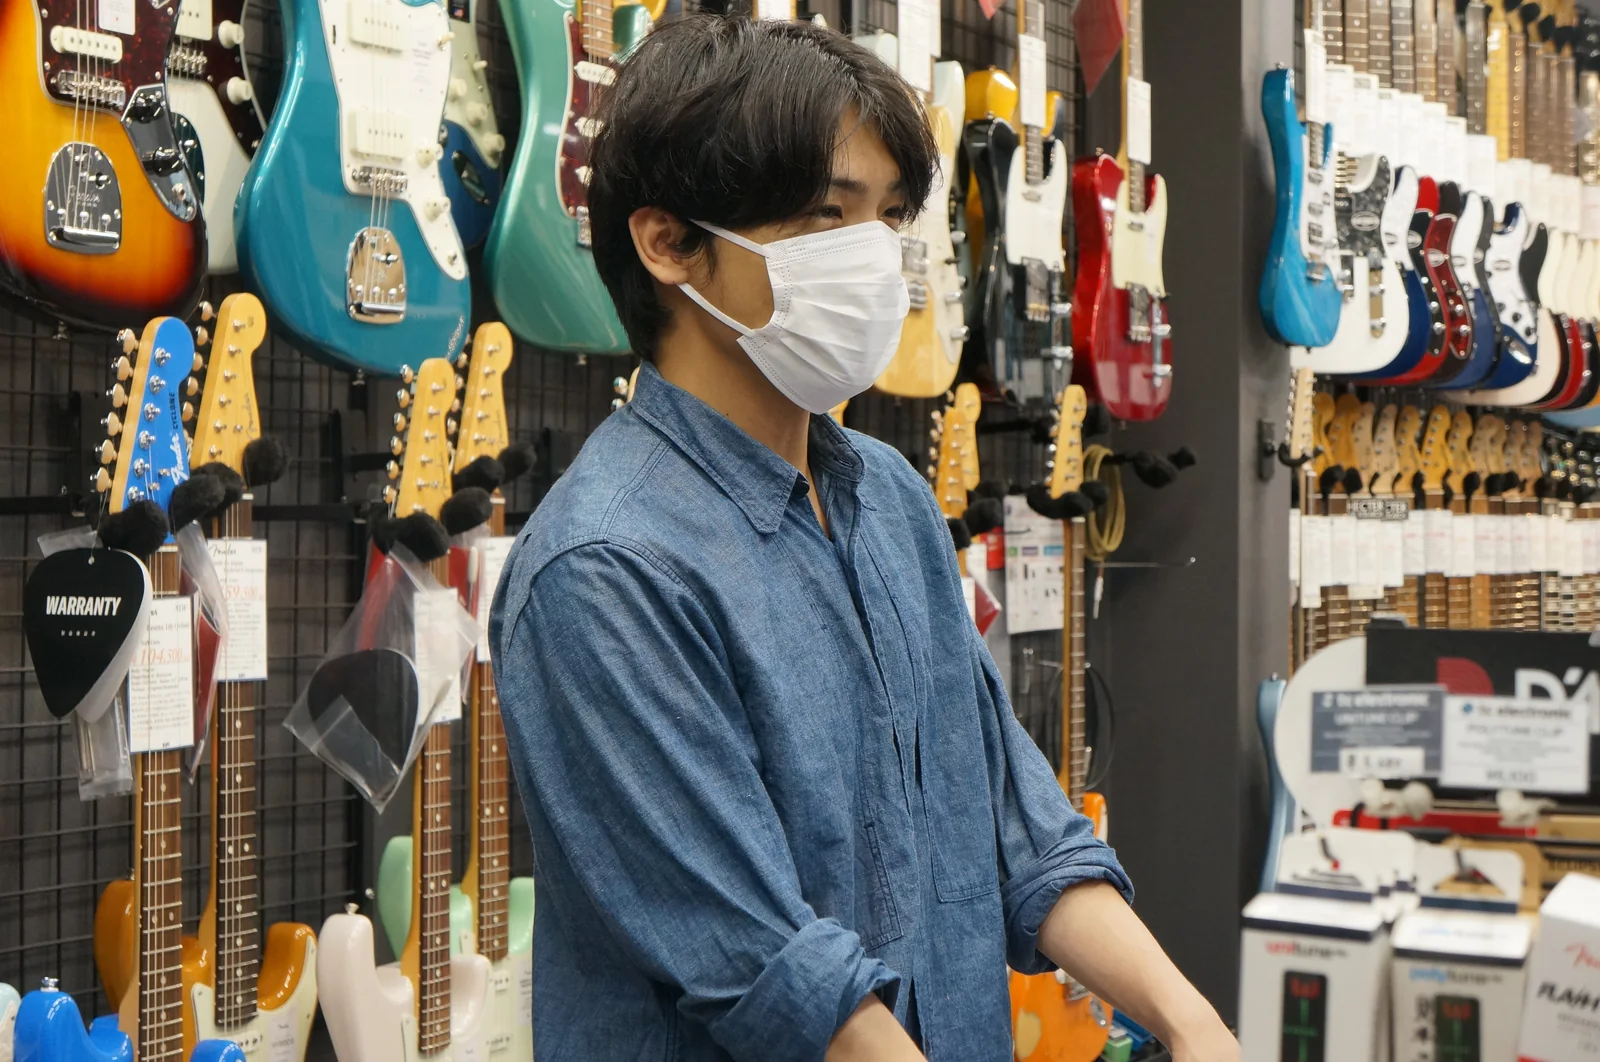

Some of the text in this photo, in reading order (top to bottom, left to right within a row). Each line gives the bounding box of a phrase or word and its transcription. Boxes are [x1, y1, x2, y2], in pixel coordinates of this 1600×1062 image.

[169, 391, 178, 430] CYCLONE
[170, 432, 189, 485] Fender
[46, 595, 122, 616] WARRANTY
